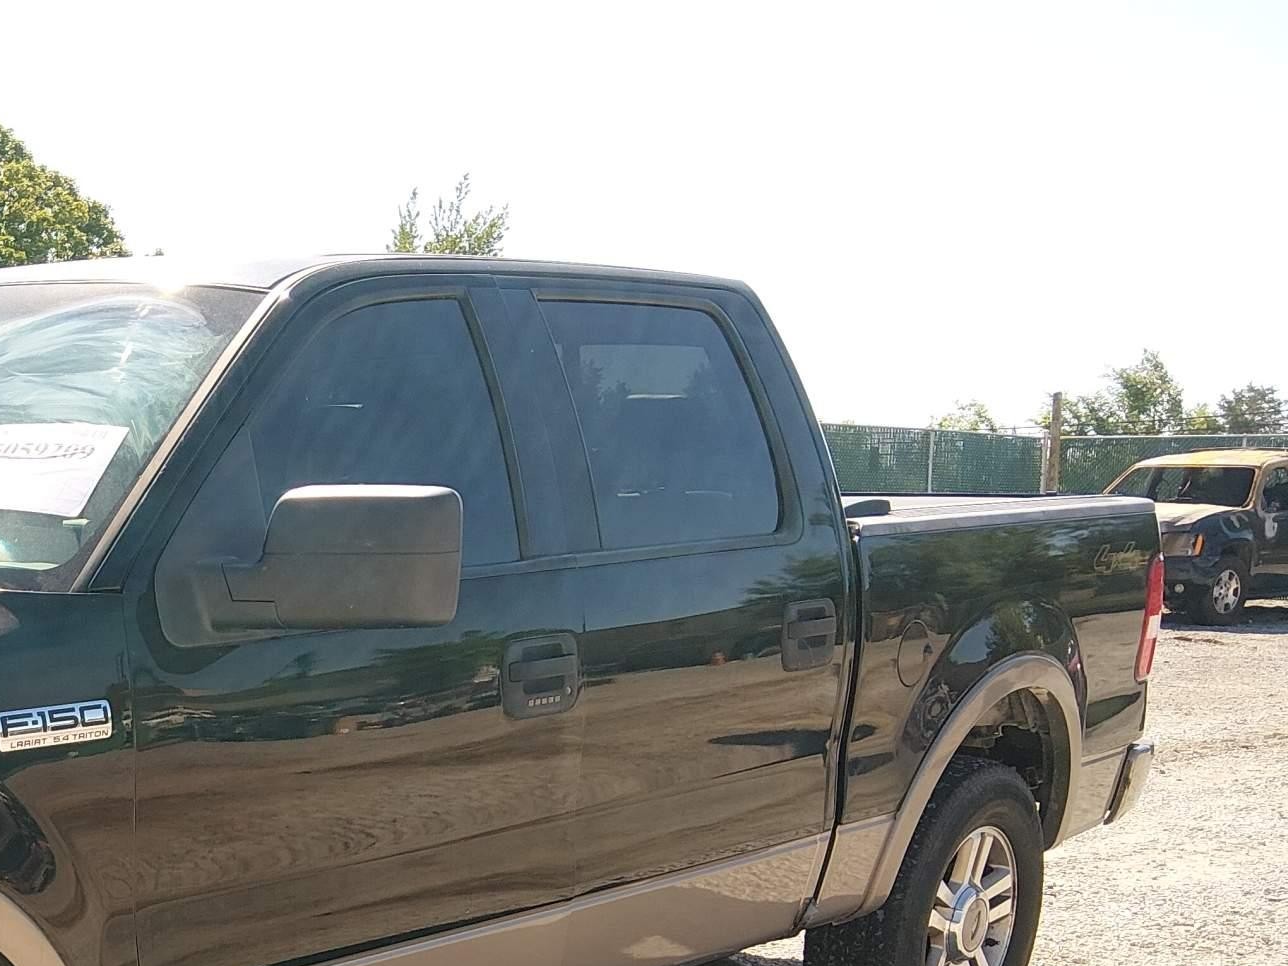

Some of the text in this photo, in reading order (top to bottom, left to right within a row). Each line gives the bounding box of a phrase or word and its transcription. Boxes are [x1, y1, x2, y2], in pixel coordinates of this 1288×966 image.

[0, 704, 109, 738] F-150
[10, 737, 47, 749] LARIAT
[72, 730, 109, 740] TRITON
